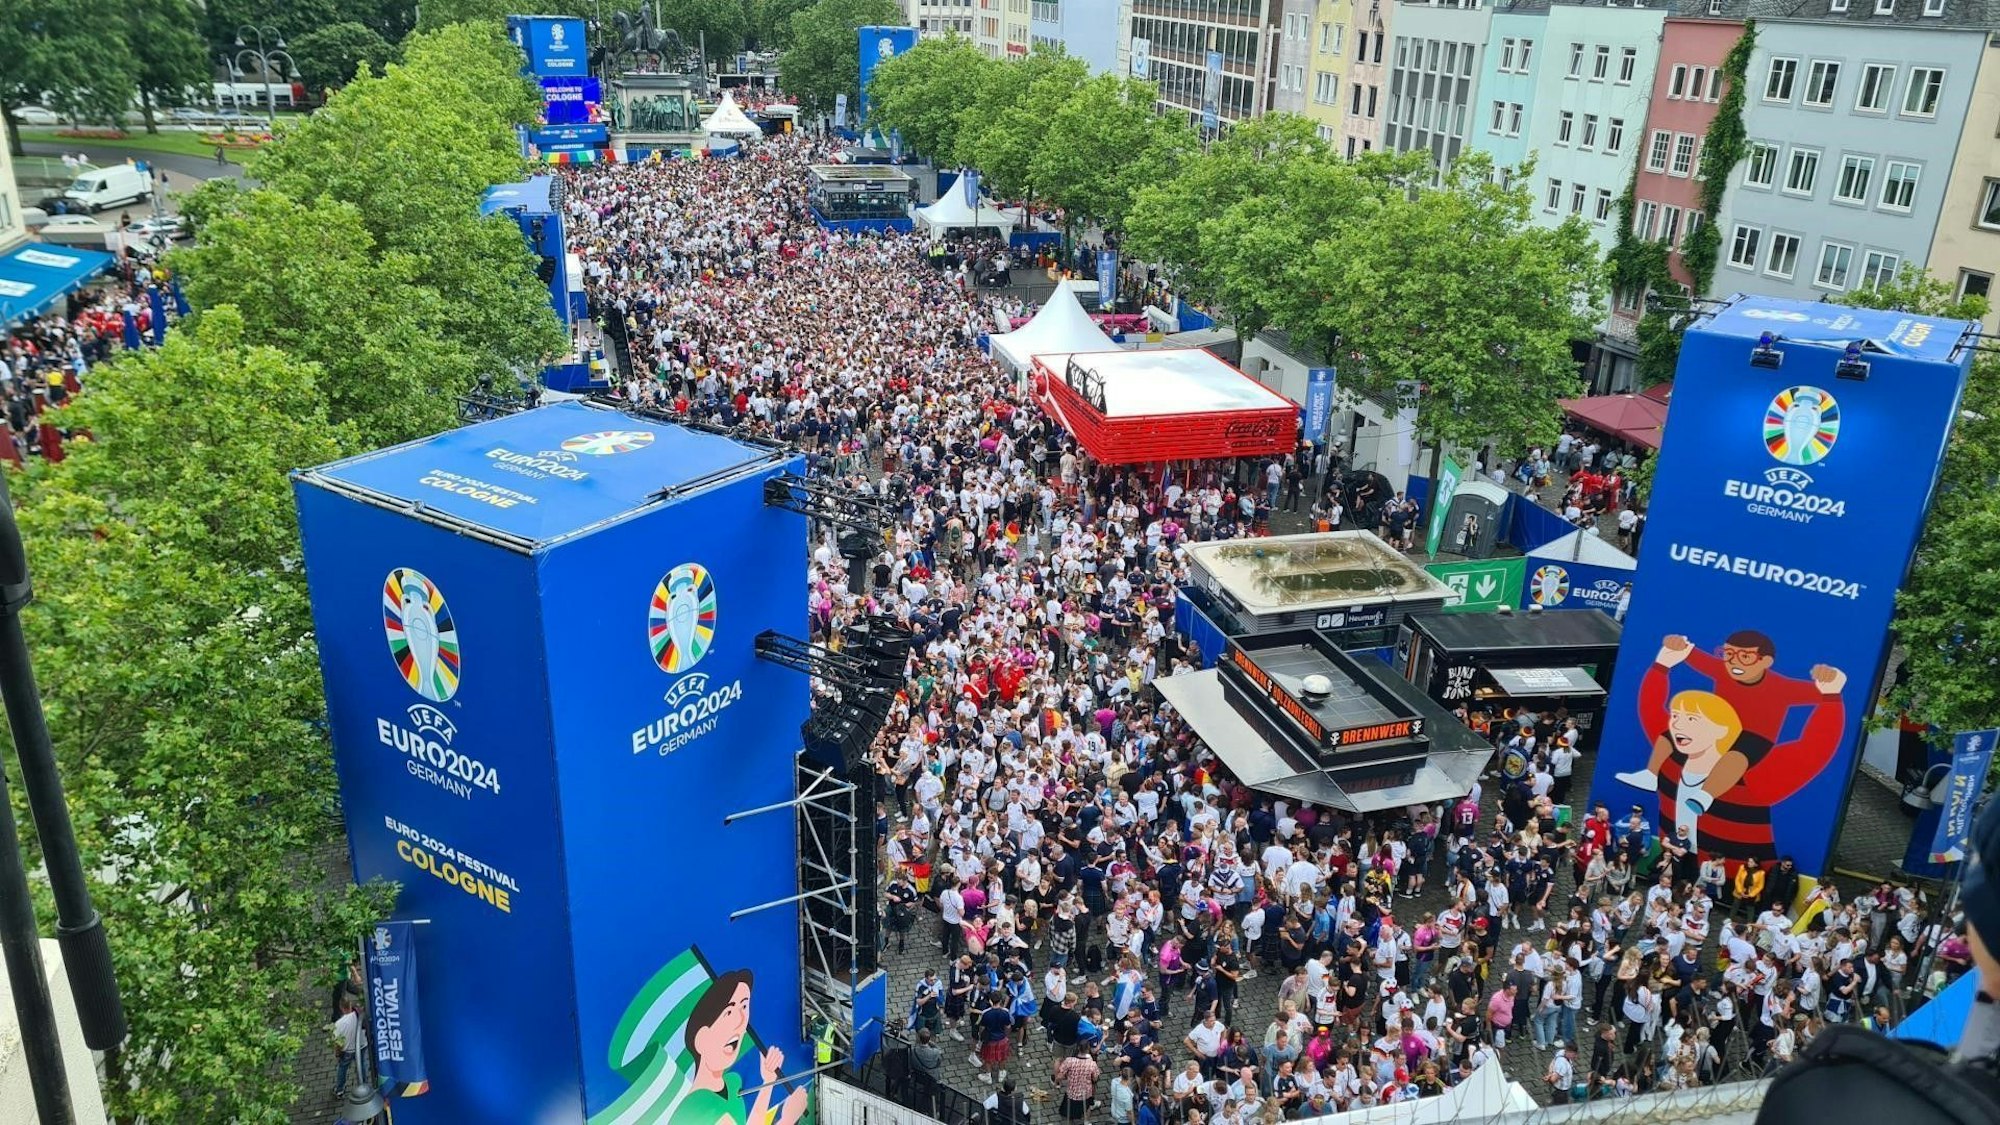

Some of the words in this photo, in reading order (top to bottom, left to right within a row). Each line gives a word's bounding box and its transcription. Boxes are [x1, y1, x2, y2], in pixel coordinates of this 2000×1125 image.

[546, 93, 583, 101] COLOGNE
[485, 448, 589, 481] EURO2024
[492, 462, 550, 480] GERMANY
[1765, 471, 1809, 489] UEFA
[419, 476, 519, 508] COLOGNE
[429, 469, 462, 481] EURO
[488, 484, 539, 505] FESTIVAL
[1724, 479, 1846, 518] EURO2024
[1746, 503, 1814, 524] GERMANY
[1348, 611, 1384, 625] Heumarkt
[1234, 651, 1269, 688] BRENNWERK
[1448, 665, 1476, 680] BUNS
[667, 677, 706, 706] UEFA
[1441, 685, 1472, 700] SONS
[410, 709, 453, 742] UEFA
[632, 679, 743, 755] EURO2024
[1342, 722, 1411, 745] BRENNWERK
[658, 714, 719, 756] GERMANY
[377, 717, 501, 795] EURO2024
[406, 759, 472, 801] GERMANY
[1462, 812, 1473, 825] 13
[384, 815, 420, 842] EURO
[421, 833, 456, 860] 2024
[456, 851, 521, 894] FESTIVAL
[397, 839, 512, 914] COLOGNE
[383, 978, 405, 1062] FESTIVAL
